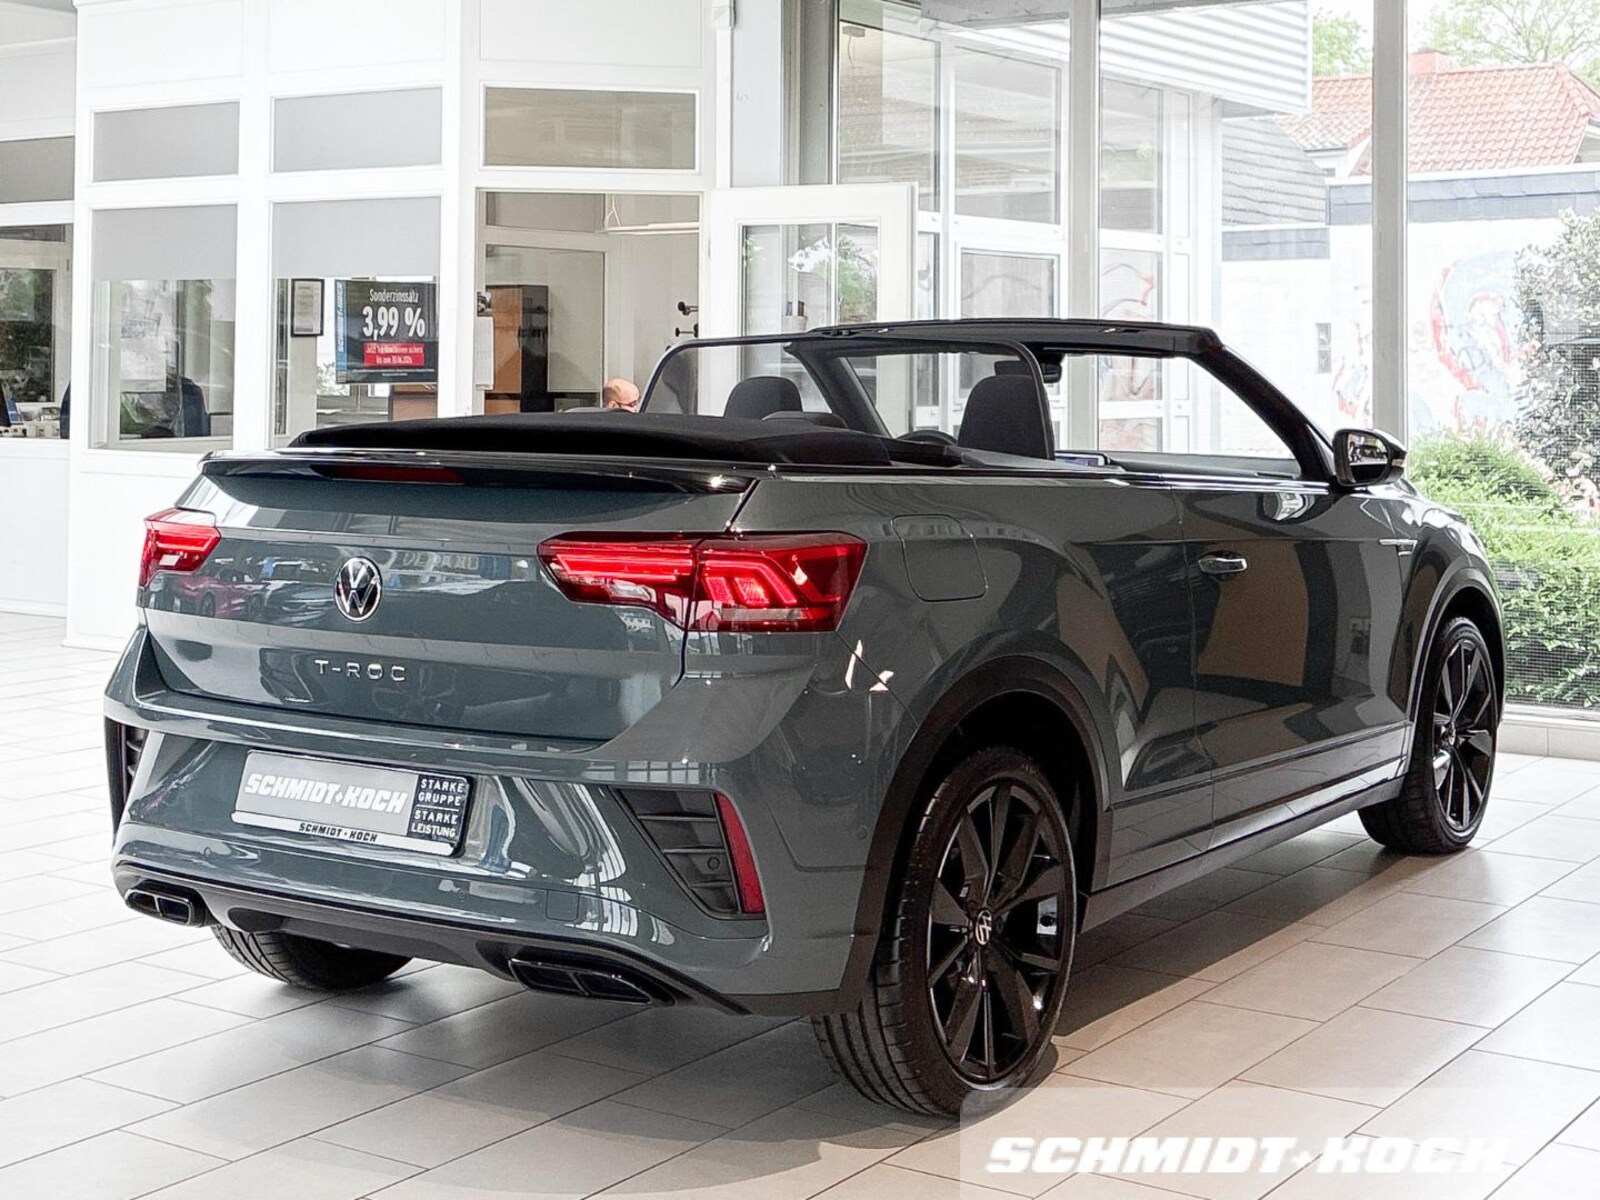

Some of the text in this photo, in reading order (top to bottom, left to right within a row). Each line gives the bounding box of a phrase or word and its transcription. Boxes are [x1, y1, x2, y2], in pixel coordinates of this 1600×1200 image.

[362, 306, 399, 341] 3,99
[404, 307, 426, 338] %
[314, 659, 406, 682] T-ROC
[421, 778, 465, 793] STARKE
[418, 791, 462, 806] GRUPPE
[414, 809, 459, 825] STARKE
[410, 822, 456, 838] LEISTUNG
